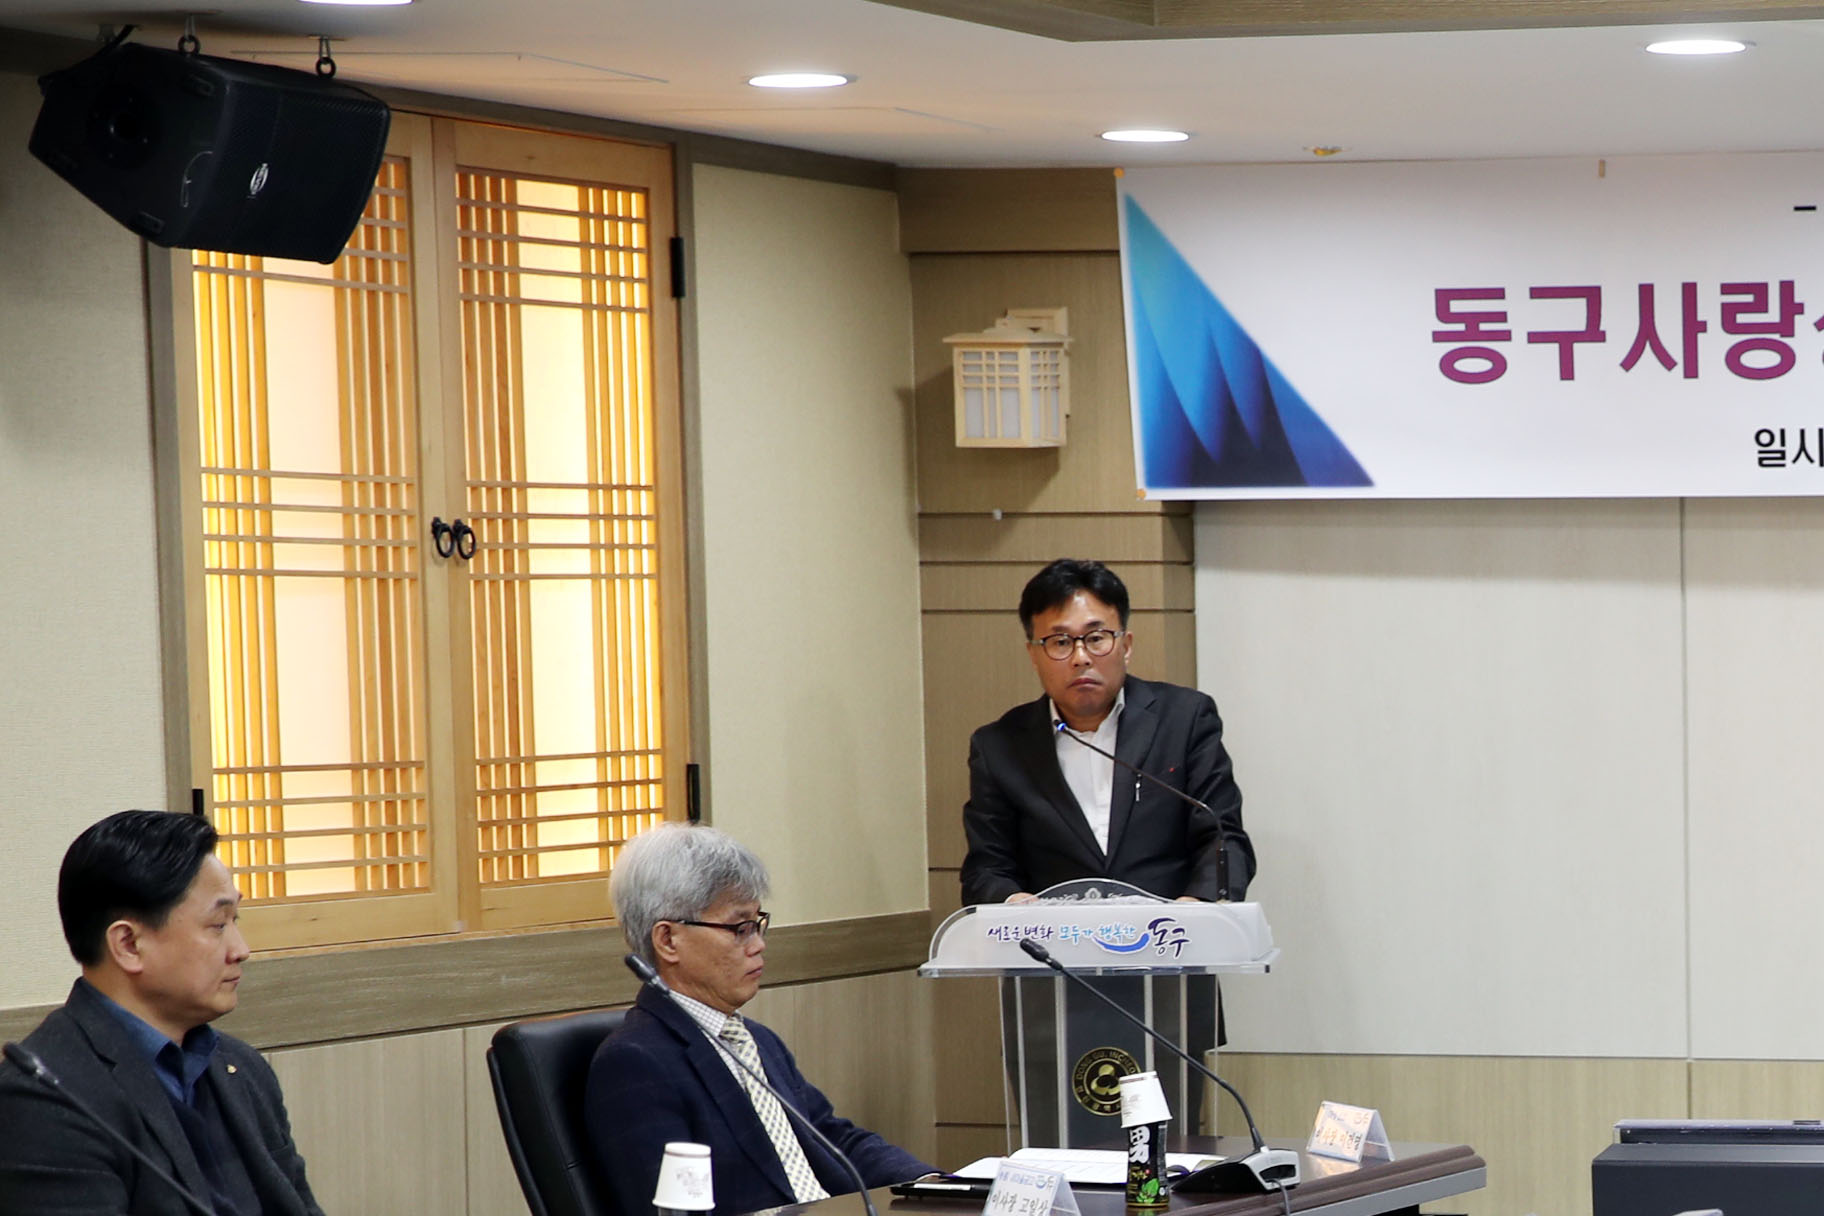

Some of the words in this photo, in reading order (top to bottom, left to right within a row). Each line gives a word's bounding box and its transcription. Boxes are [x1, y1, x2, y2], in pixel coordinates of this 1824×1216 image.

[1754, 427, 1824, 468] 일시
[987, 925, 1022, 941] 새로운
[1024, 926, 1055, 941] 변화
[1059, 925, 1094, 943] 모두가
[1100, 925, 1137, 943] 행복한
[1147, 917, 1191, 957] 동구
